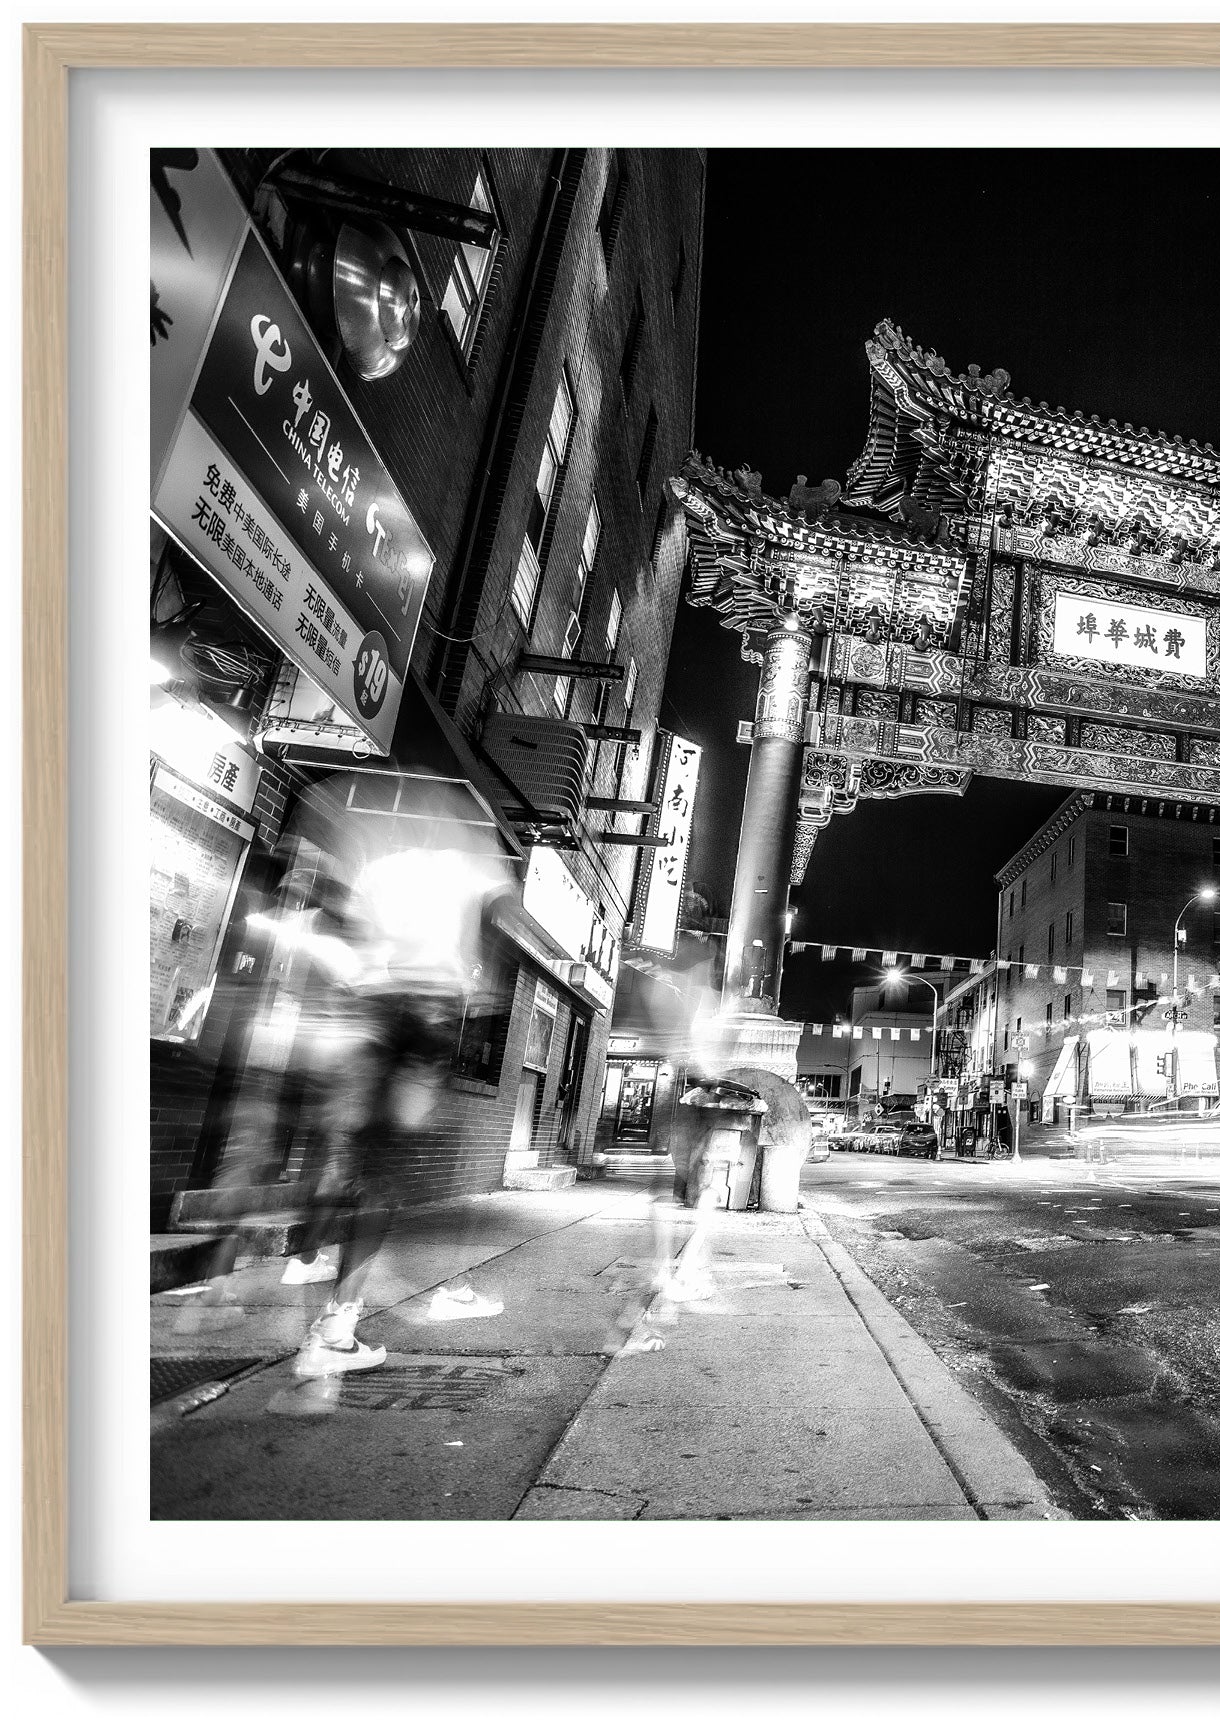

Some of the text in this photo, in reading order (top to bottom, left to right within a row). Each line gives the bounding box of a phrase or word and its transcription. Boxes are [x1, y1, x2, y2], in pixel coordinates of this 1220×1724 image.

[282, 419, 350, 526] CHINA TELECOM
[297, 488, 364, 588] 美国手机卡
[358, 649, 387, 702] $19
[207, 751, 240, 793] 房產
